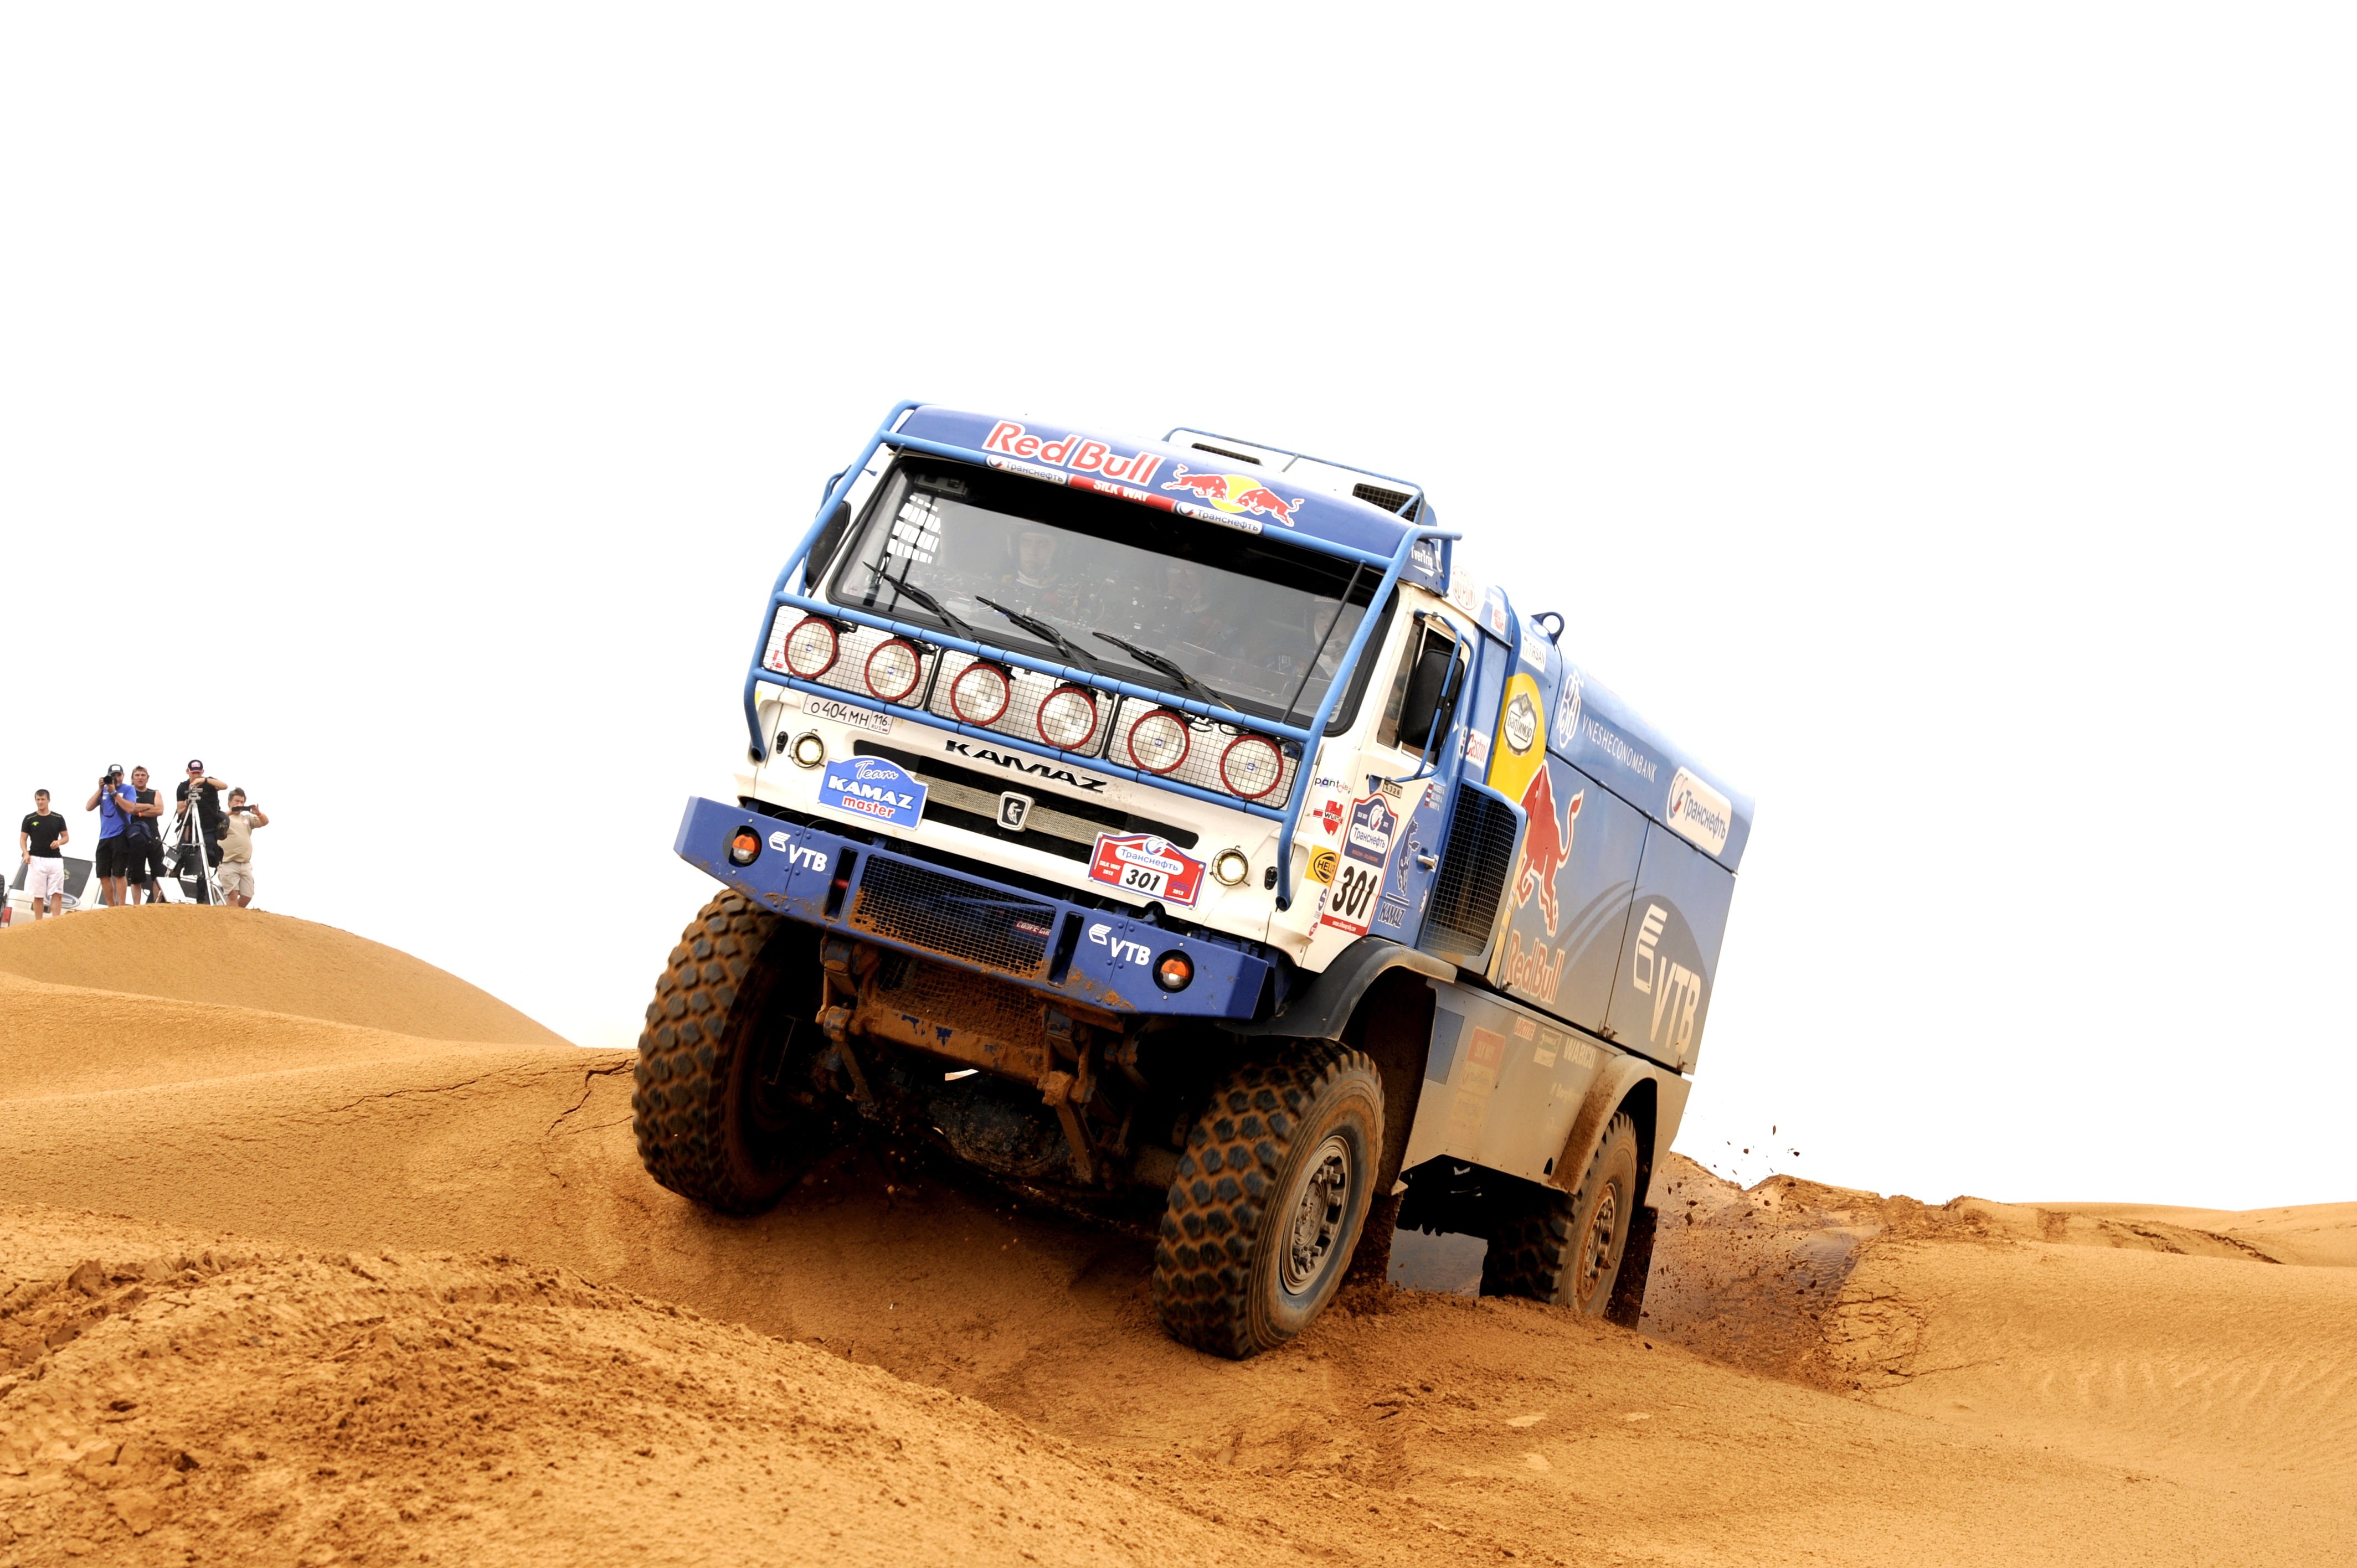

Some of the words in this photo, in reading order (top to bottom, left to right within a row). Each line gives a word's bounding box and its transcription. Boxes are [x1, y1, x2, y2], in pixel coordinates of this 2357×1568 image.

[1006, 460, 1064, 483] Транснефть
[1093, 479, 1119, 495] SILK
[1122, 486, 1151, 502] WAY
[1197, 509, 1259, 532] Транснефть
[873, 714, 888, 726] 116
[1466, 733, 1489, 764] Castrol
[1582, 713, 1658, 783] VNESHECONOMBANK
[855, 760, 899, 780] Team
[945, 739, 1107, 793] KAMAZ
[827, 775, 914, 810] KAMAZ
[842, 796, 894, 818] master
[1682, 790, 1726, 840] Транснефть
[1354, 827, 1386, 849] Транснефть
[789, 844, 828, 872] VTB
[1110, 863, 1121, 871] WAY
[1121, 848, 1179, 871] Транснефть
[1125, 869, 1161, 891] 301
[1332, 865, 1378, 920] 301
[1378, 901, 1406, 929] KAMAZ
[1111, 936, 1151, 966] VTB
[1650, 956, 1701, 1056] VTB
